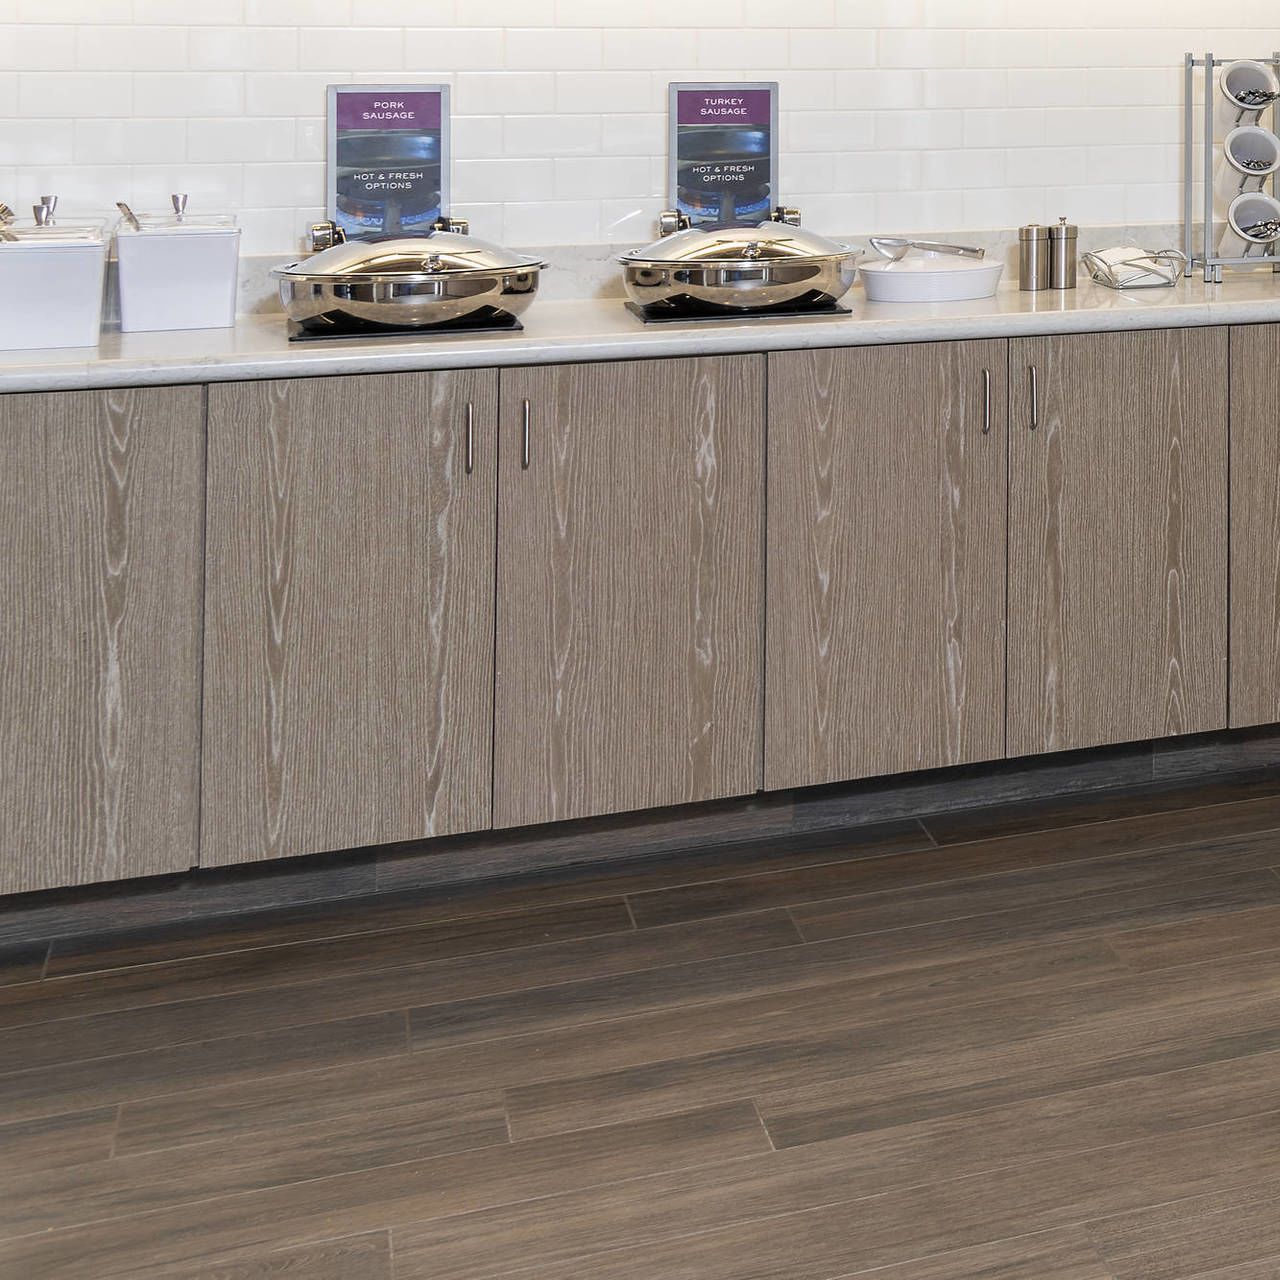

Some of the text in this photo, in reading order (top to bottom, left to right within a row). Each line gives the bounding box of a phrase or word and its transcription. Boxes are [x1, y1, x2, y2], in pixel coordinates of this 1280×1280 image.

[373, 101, 405, 109] PORK
[704, 98, 745, 106] TURKEY
[362, 111, 416, 120] SAUSAGE
[700, 107, 748, 116] SAUSAGE
[692, 166, 712, 174] HOT
[353, 173, 376, 181] HOT
[388, 172, 424, 180] FRESH
[702, 174, 745, 182] OPTIONS
[364, 181, 412, 190] OPTIONS
